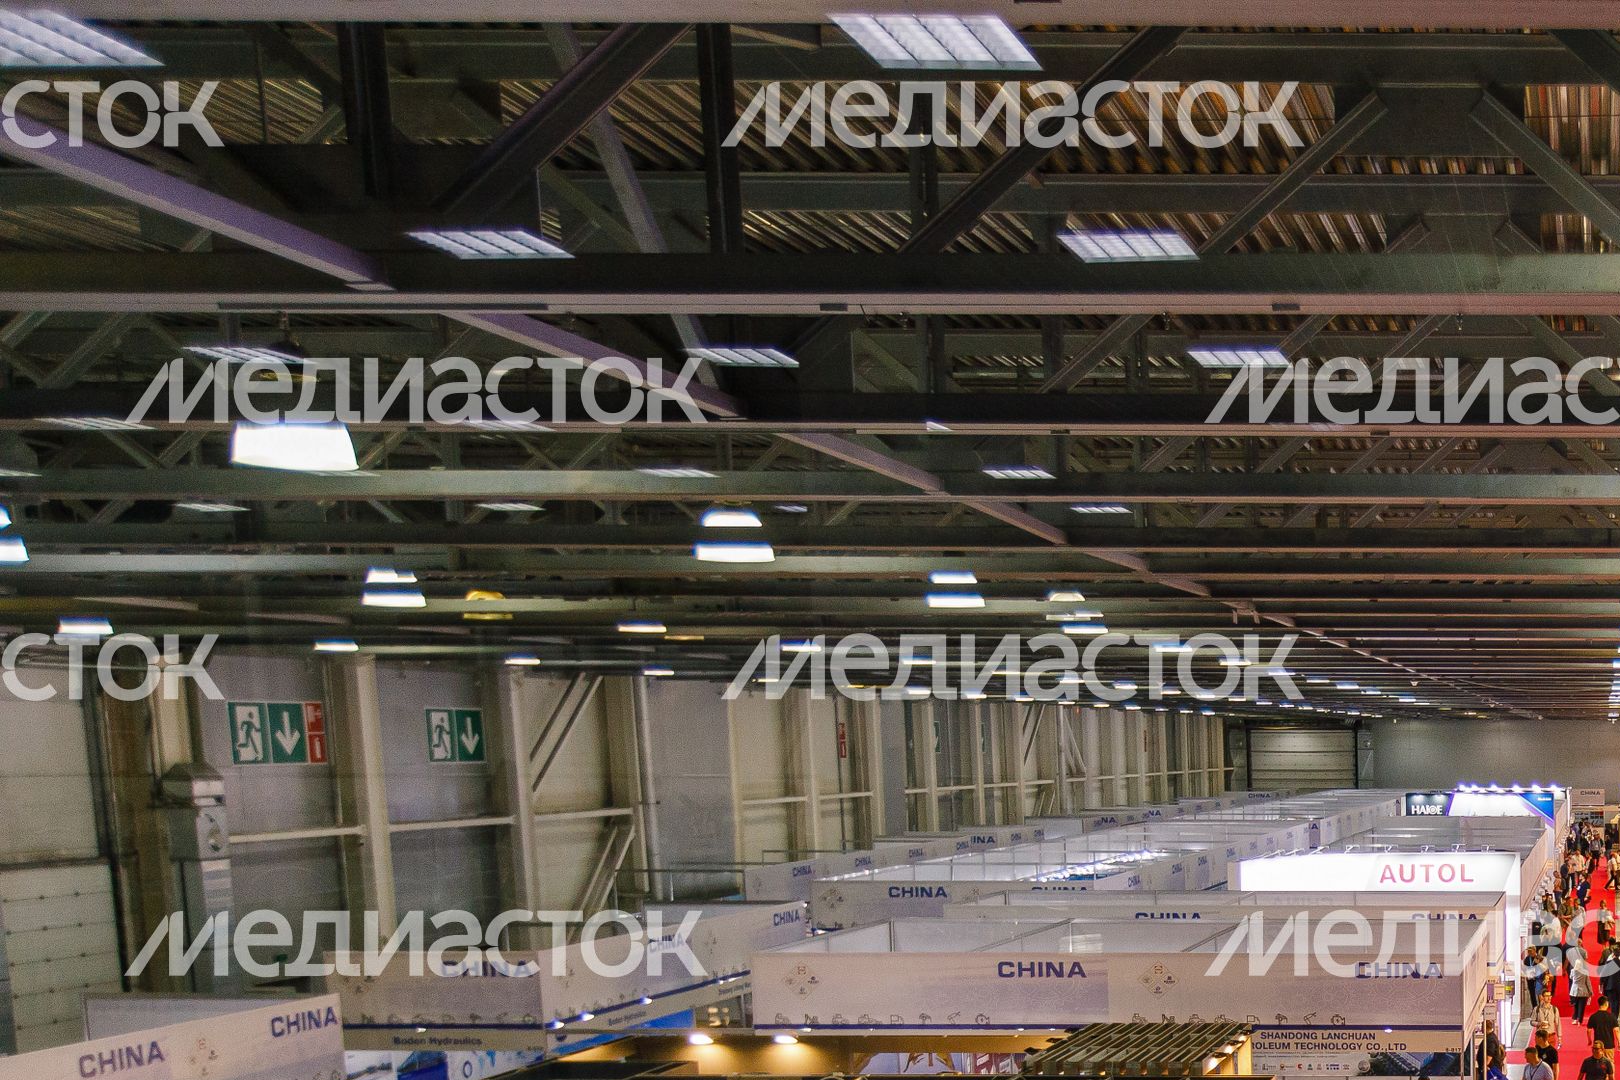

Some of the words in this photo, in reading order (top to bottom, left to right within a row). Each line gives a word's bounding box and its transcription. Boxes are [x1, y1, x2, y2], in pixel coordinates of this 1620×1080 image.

[792, 865, 812, 877] CHINA
[1379, 863, 1474, 884] AUTOL
[888, 886, 947, 898] CHINA
[773, 909, 800, 927] CHINA
[440, 960, 532, 978] CHINA
[997, 961, 1087, 979] CHINA
[1354, 961, 1444, 980] CHINA
[271, 1006, 339, 1038] CHINA
[393, 1036, 426, 1046] Boden
[429, 1036, 482, 1047] Hydraulics
[1260, 1032, 1317, 1040] SHANDONG
[1321, 1032, 1376, 1041] LANCHUAN
[1300, 1042, 1362, 1051] TECHNOLOGY
[79, 1041, 165, 1078] CHINA
